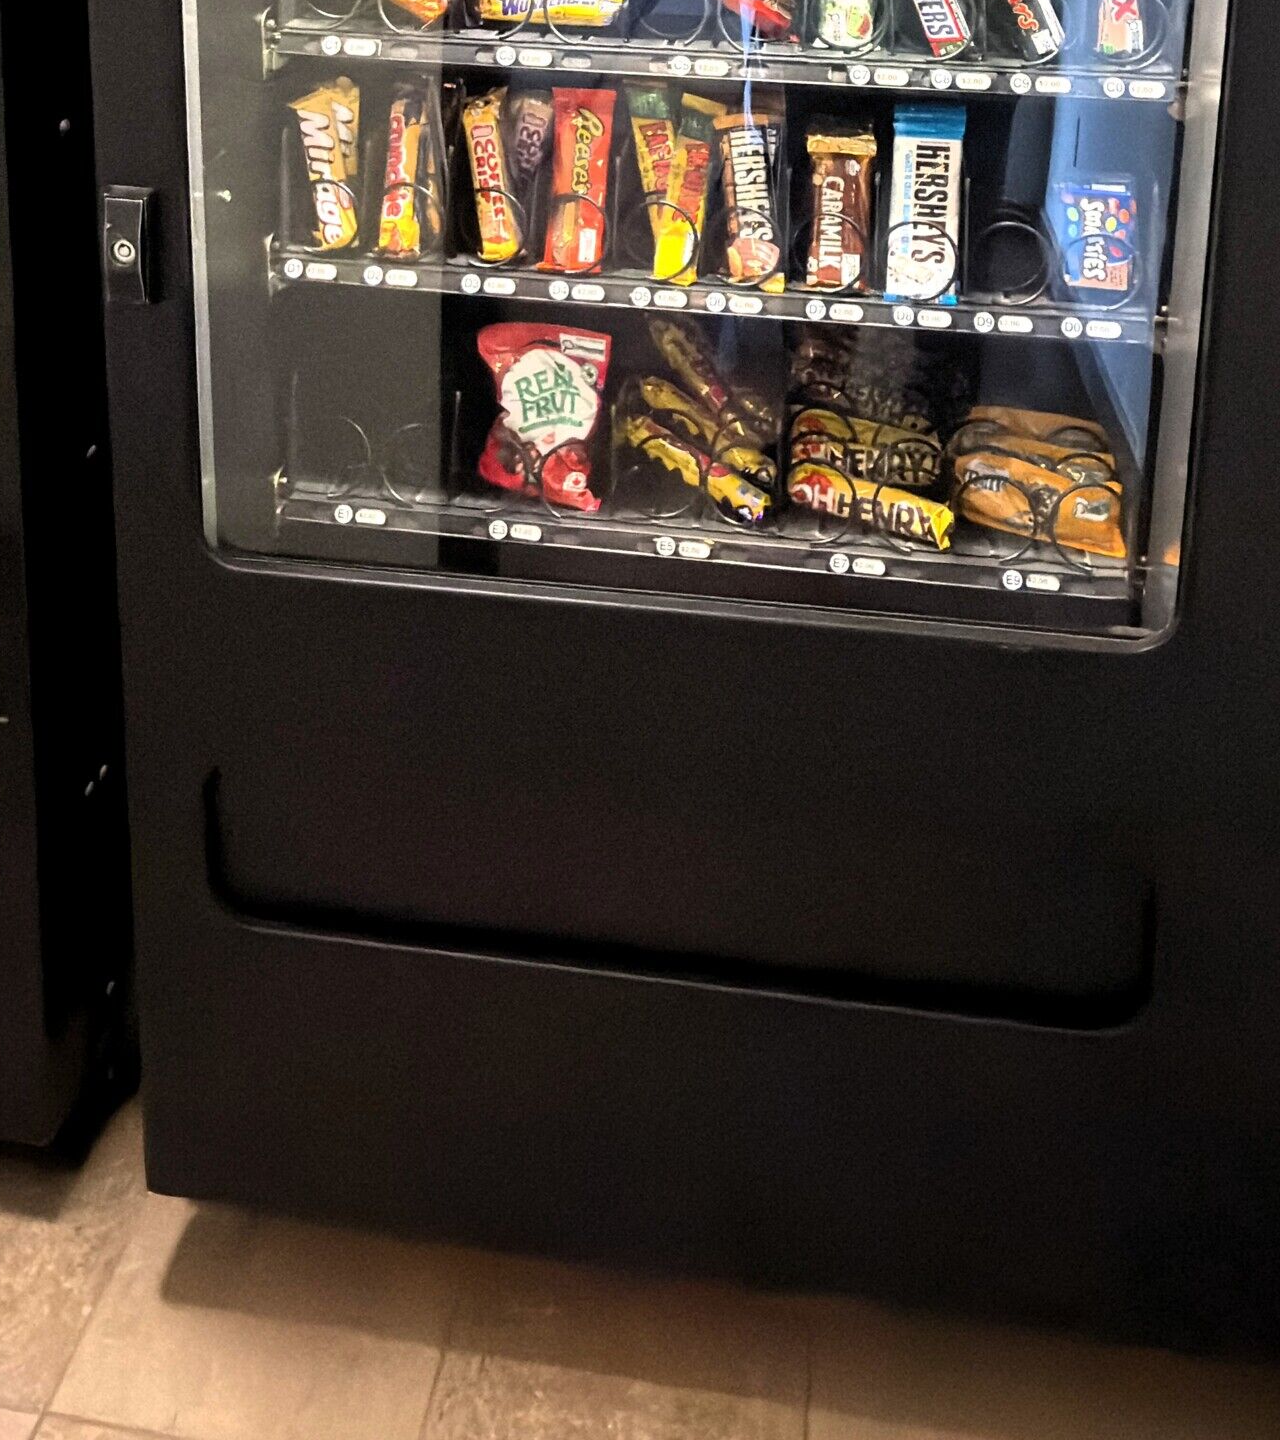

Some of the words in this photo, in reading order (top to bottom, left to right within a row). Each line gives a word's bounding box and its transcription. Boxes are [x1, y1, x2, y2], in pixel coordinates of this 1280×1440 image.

[852, 70, 869, 80] C7
[911, 143, 951, 265] HERSHEY'S
[818, 175, 845, 270] CARAMILK
[977, 316, 993, 327] D9
[659, 540, 673, 551] E5
[833, 557, 847, 568] E7
[1006, 574, 1021, 585] E9
